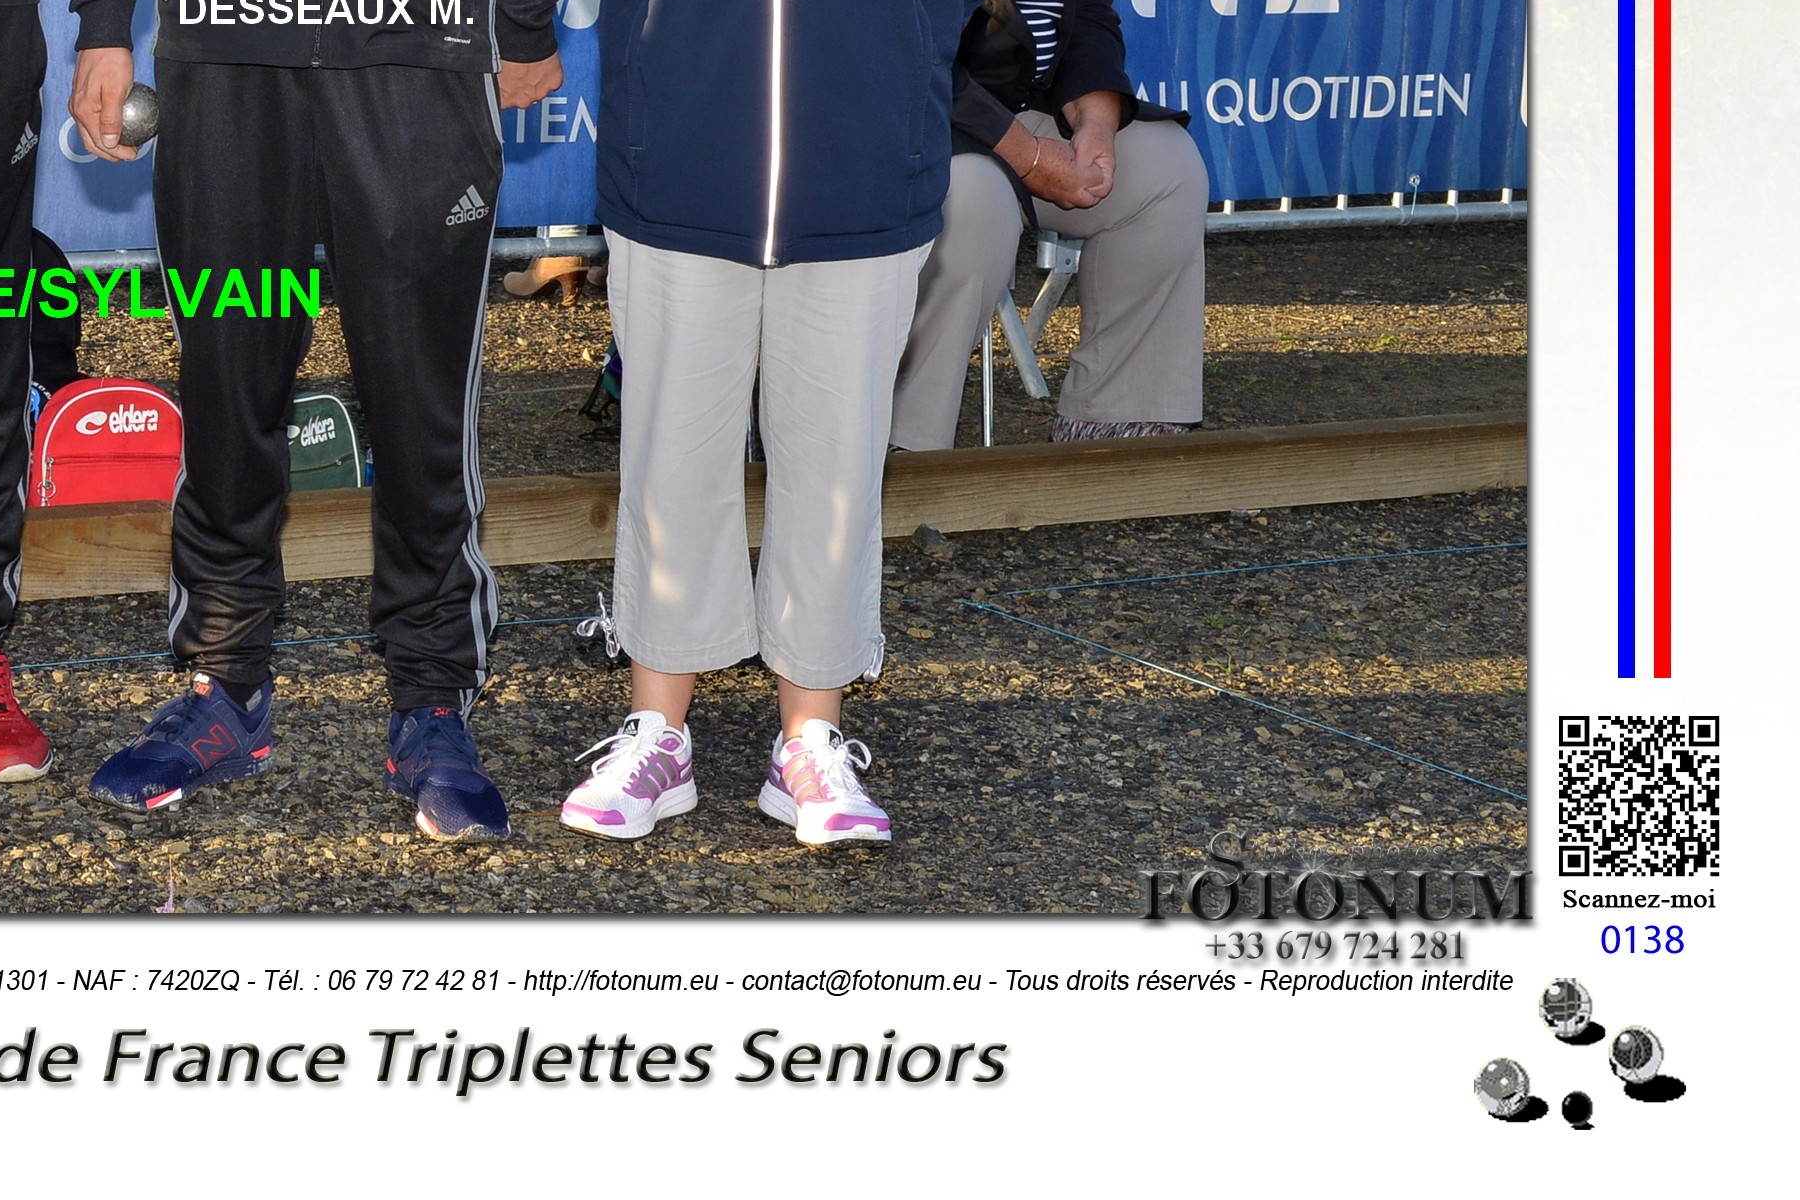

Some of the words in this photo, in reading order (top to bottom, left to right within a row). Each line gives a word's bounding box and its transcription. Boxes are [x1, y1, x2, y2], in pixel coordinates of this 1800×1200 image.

[1205, 72, 1472, 127] QUOTIDIEN
[445, 206, 490, 226] adidas
[108, 403, 159, 434] eldera
[300, 414, 336, 447] eldera
